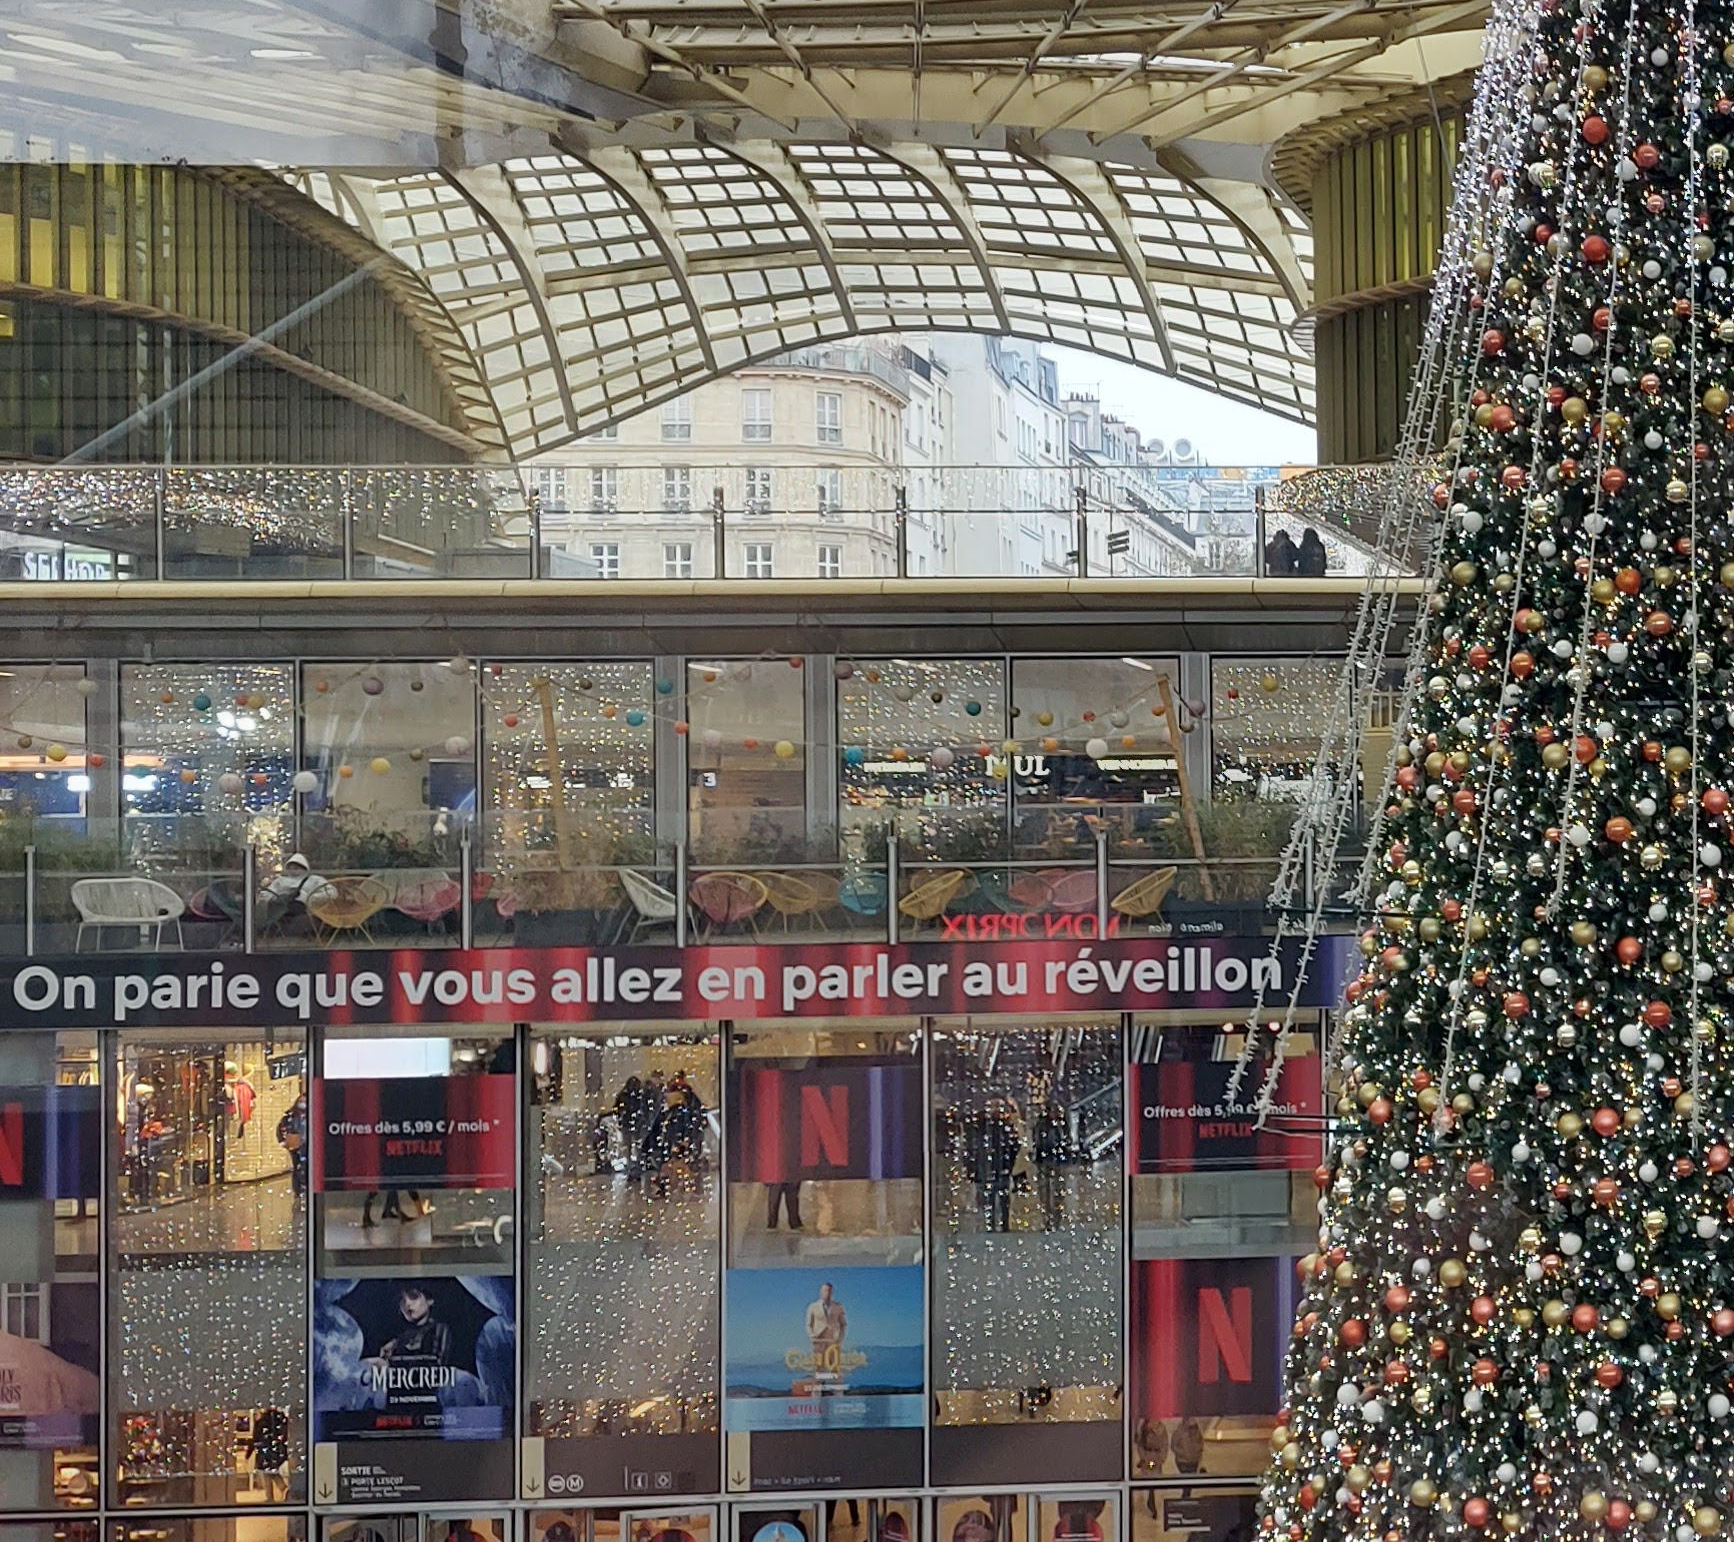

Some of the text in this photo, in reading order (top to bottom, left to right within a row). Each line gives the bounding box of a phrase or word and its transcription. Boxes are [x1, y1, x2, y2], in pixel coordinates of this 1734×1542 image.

[13, 948, 1282, 1020] On parie que vous allez en parler au réveillon
[1143, 1105, 1185, 1119] Offres
[1188, 1104, 1212, 1118] dès
[328, 1122, 371, 1135] Offres
[375, 1121, 399, 1134] dès
[402, 1120, 433, 1135] 5,99
[436, 1120, 445, 1132] €
[458, 1118, 490, 1132] mois
[800, 1085, 849, 1168] N
[1199, 1122, 1252, 1138] NETFLIX
[386, 1139, 443, 1156] NETFLIX
[1197, 1285, 1252, 1383] N
[371, 1365, 457, 1393] MERCREDI
